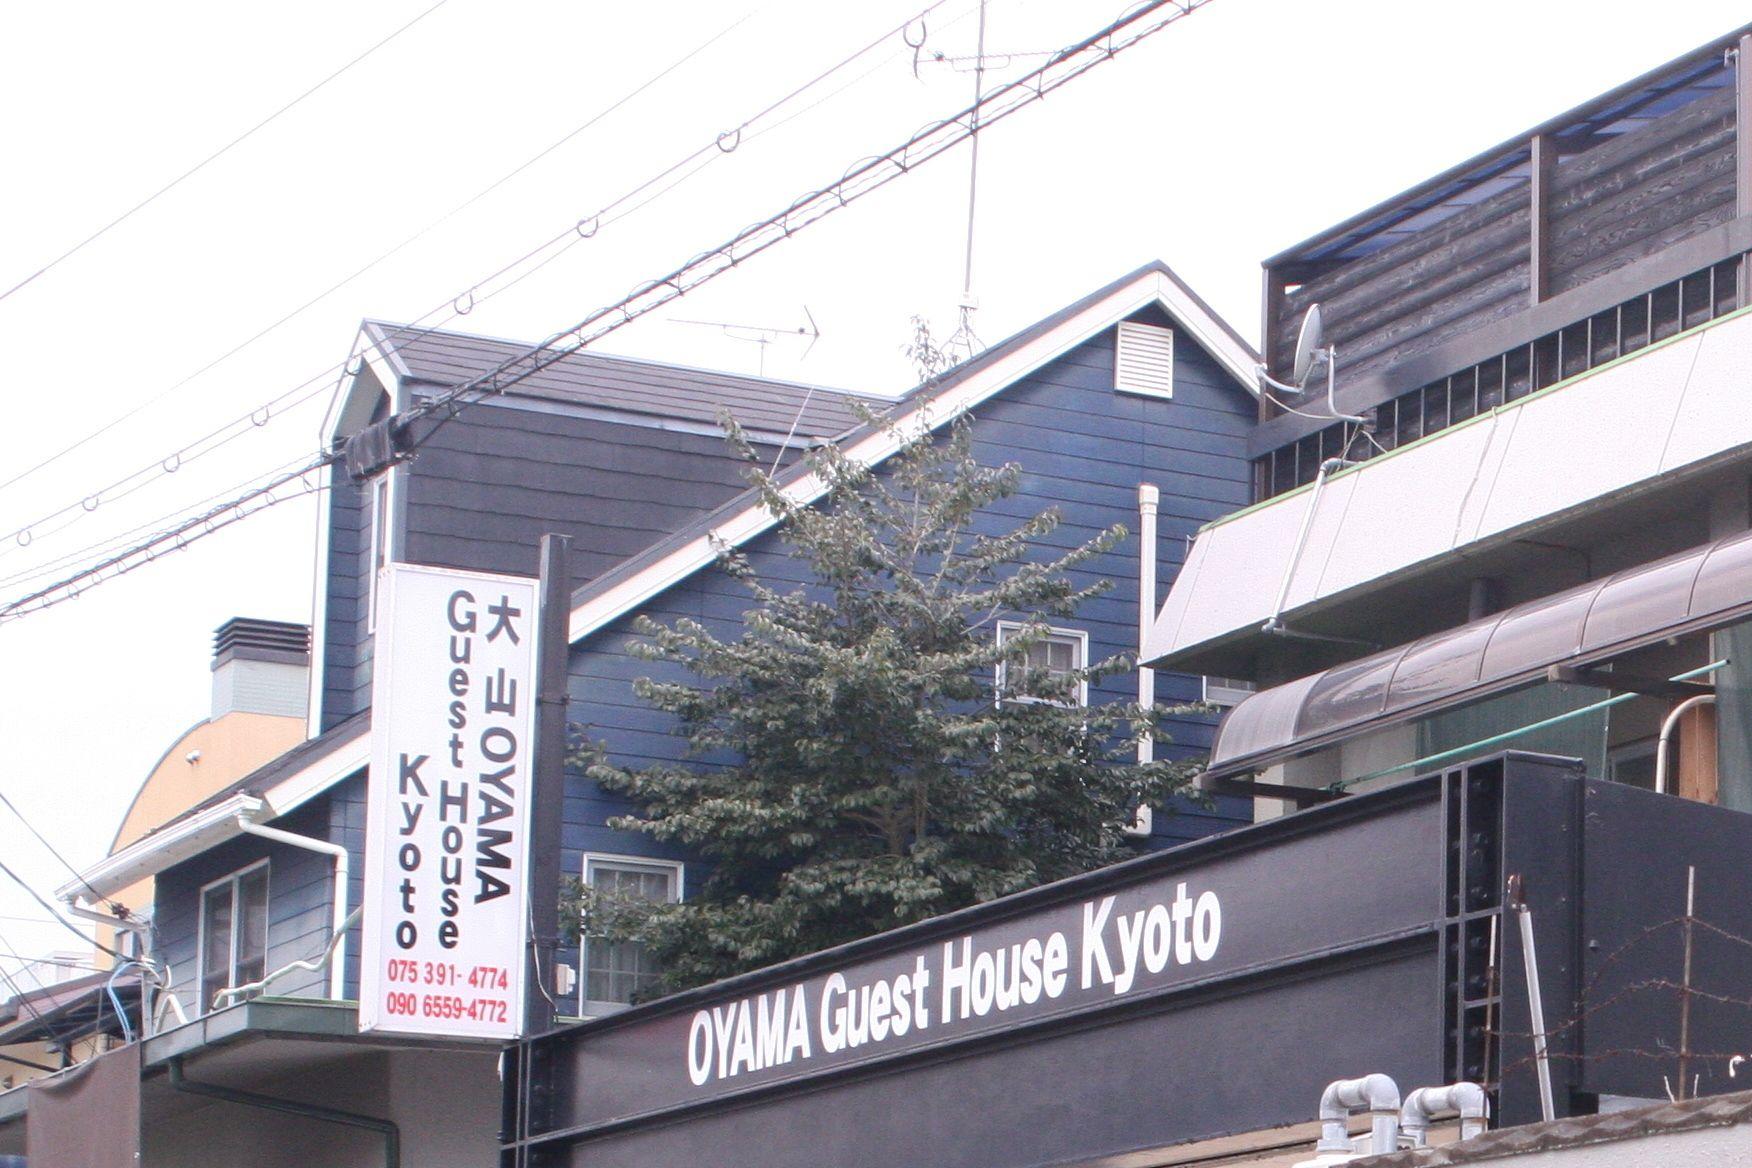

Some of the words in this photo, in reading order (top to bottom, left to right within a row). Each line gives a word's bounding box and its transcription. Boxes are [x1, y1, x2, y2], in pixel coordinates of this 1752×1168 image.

[447, 590, 477, 768] Guest
[396, 753, 430, 950] Kyoto
[438, 780, 469, 949] House
[474, 727, 518, 905] OYAMA
[387, 991, 417, 1015] 090
[388, 958, 418, 983] 075
[688, 984, 811, 1086] OYAMA
[820, 956, 930, 1053] Guest
[941, 932, 1068, 1024] House
[1081, 882, 1221, 995] Kyoto
